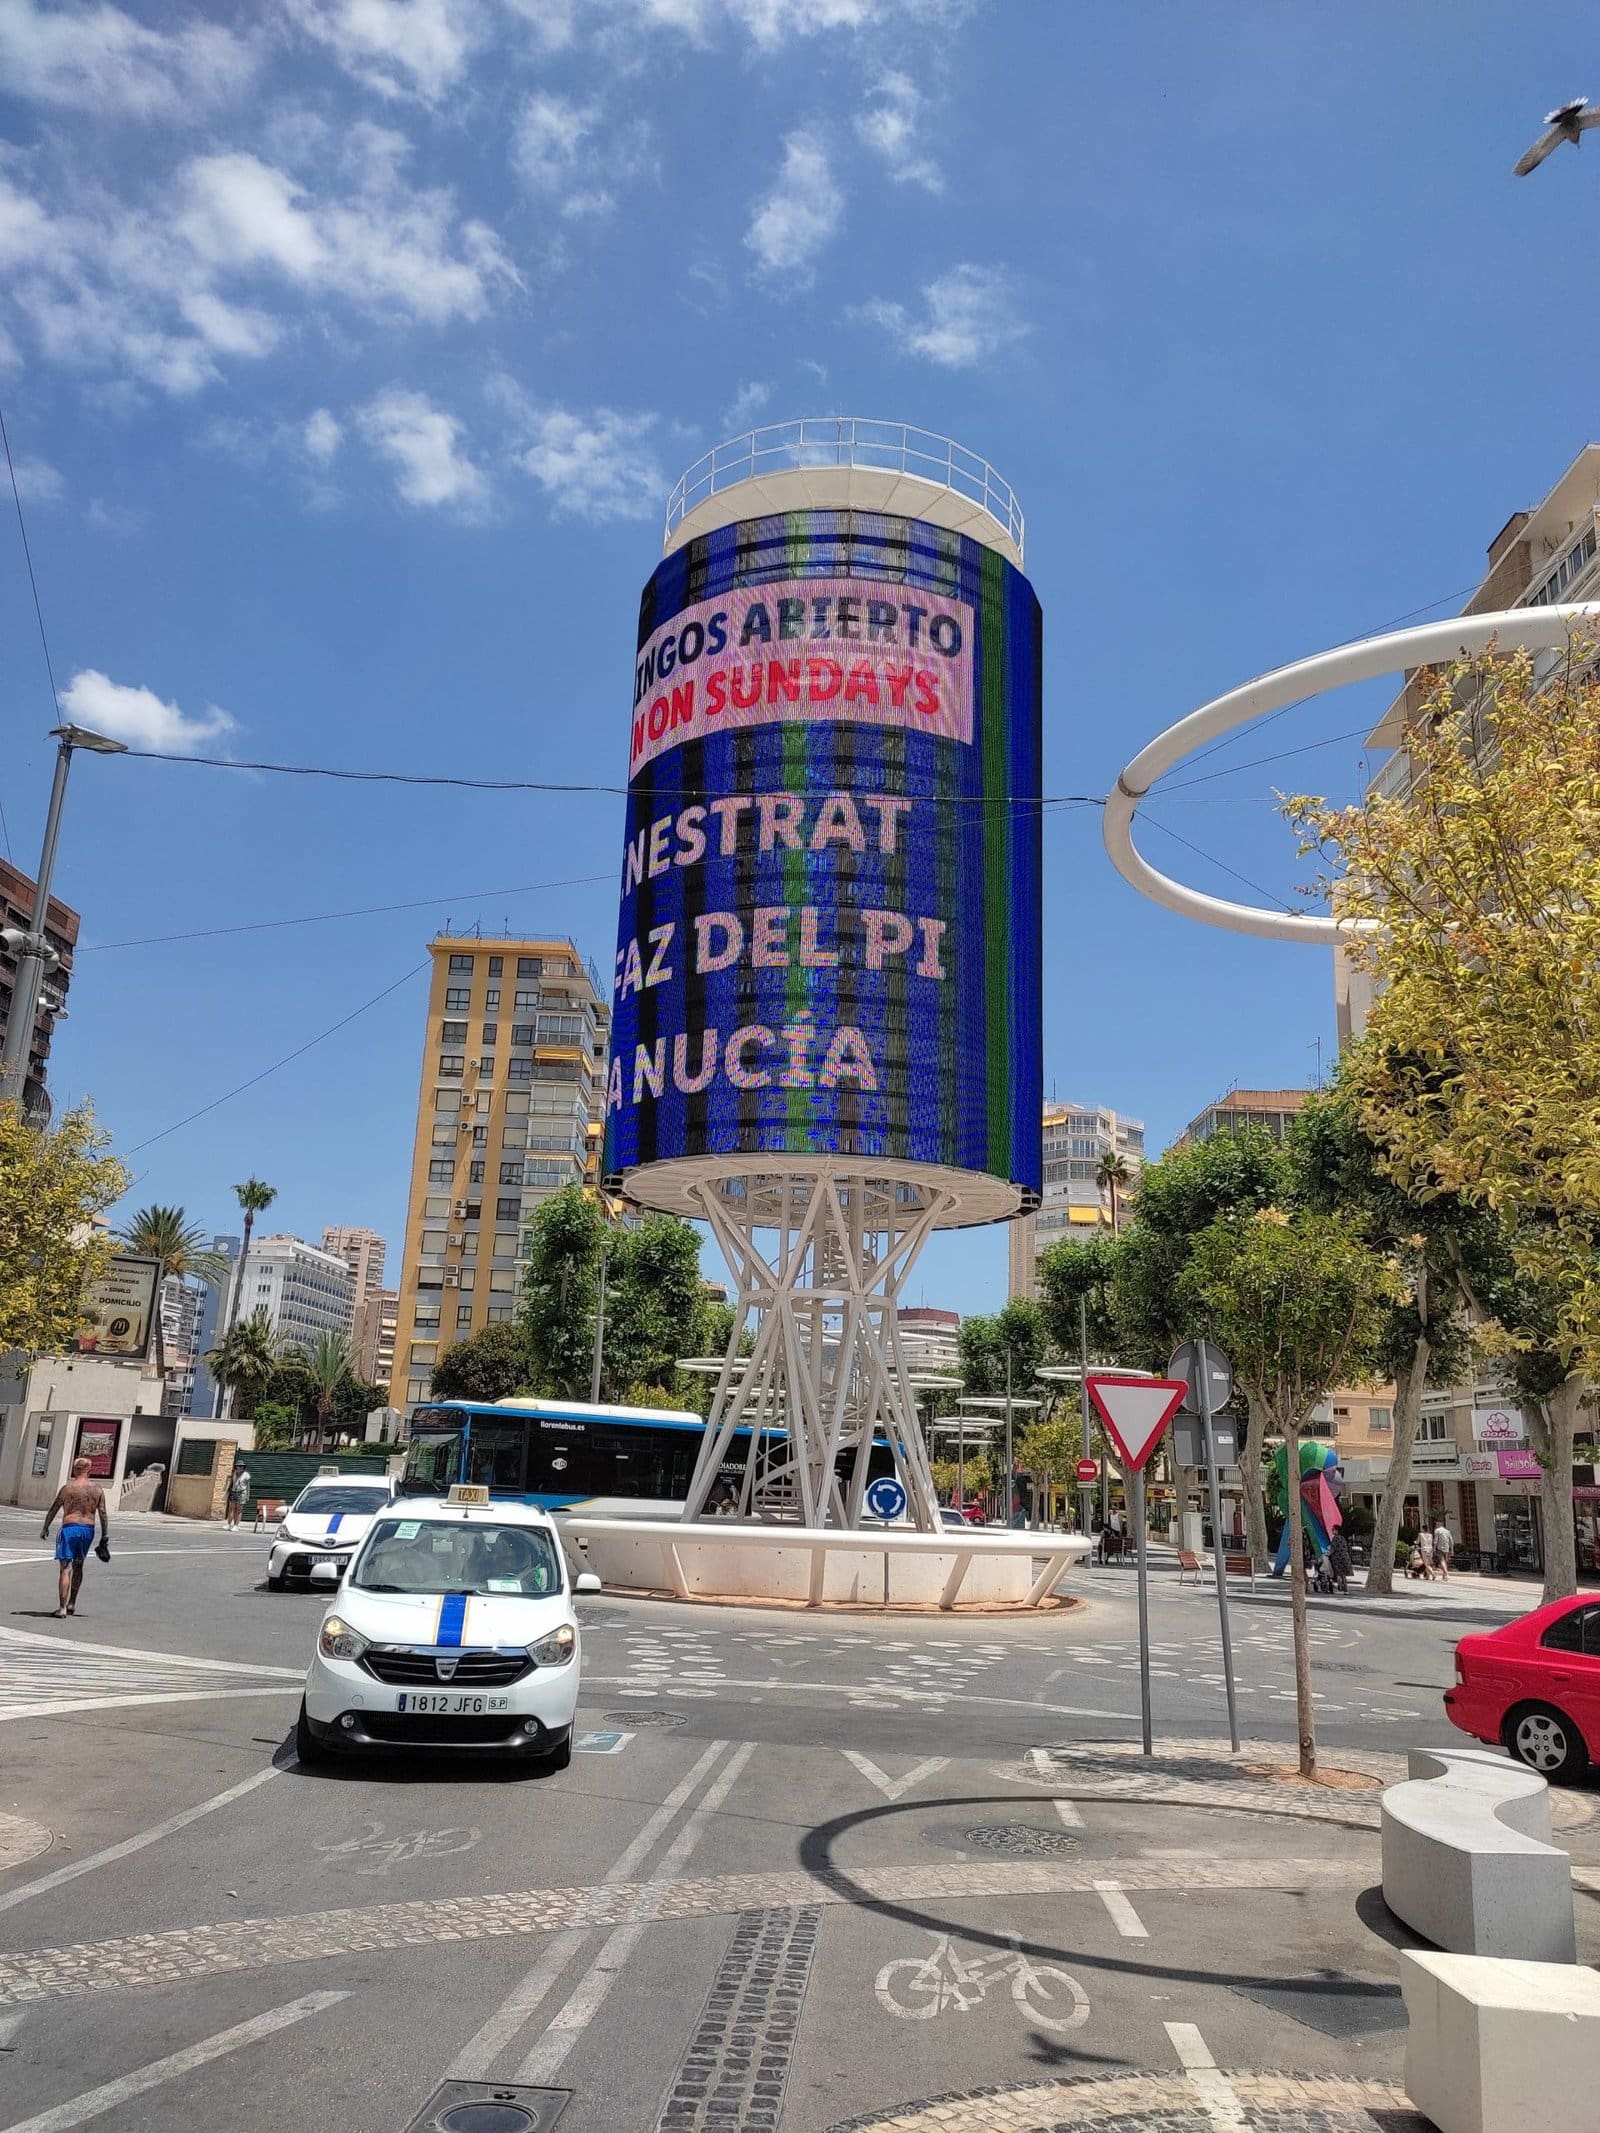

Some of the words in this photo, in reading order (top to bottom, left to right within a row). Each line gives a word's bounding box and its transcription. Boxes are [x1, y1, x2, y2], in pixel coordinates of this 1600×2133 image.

[635, 612, 728, 706] INGOS
[739, 597, 962, 658] ABIERTO
[648, 680, 694, 741] ON
[705, 658, 940, 715] SUNDAYS
[621, 792, 912, 901] NESTRAT
[695, 906, 839, 974] DEL
[861, 908, 946, 980] PI
[606, 1010, 877, 1118] ANUCÍA
[98, 1297, 142, 1307] DOMICILIO
[1481, 1430, 1518, 1439] doria
[458, 1488, 479, 1502] TAXI
[411, 1695, 449, 1712] 1812
[453, 1697, 482, 1713] JFG
